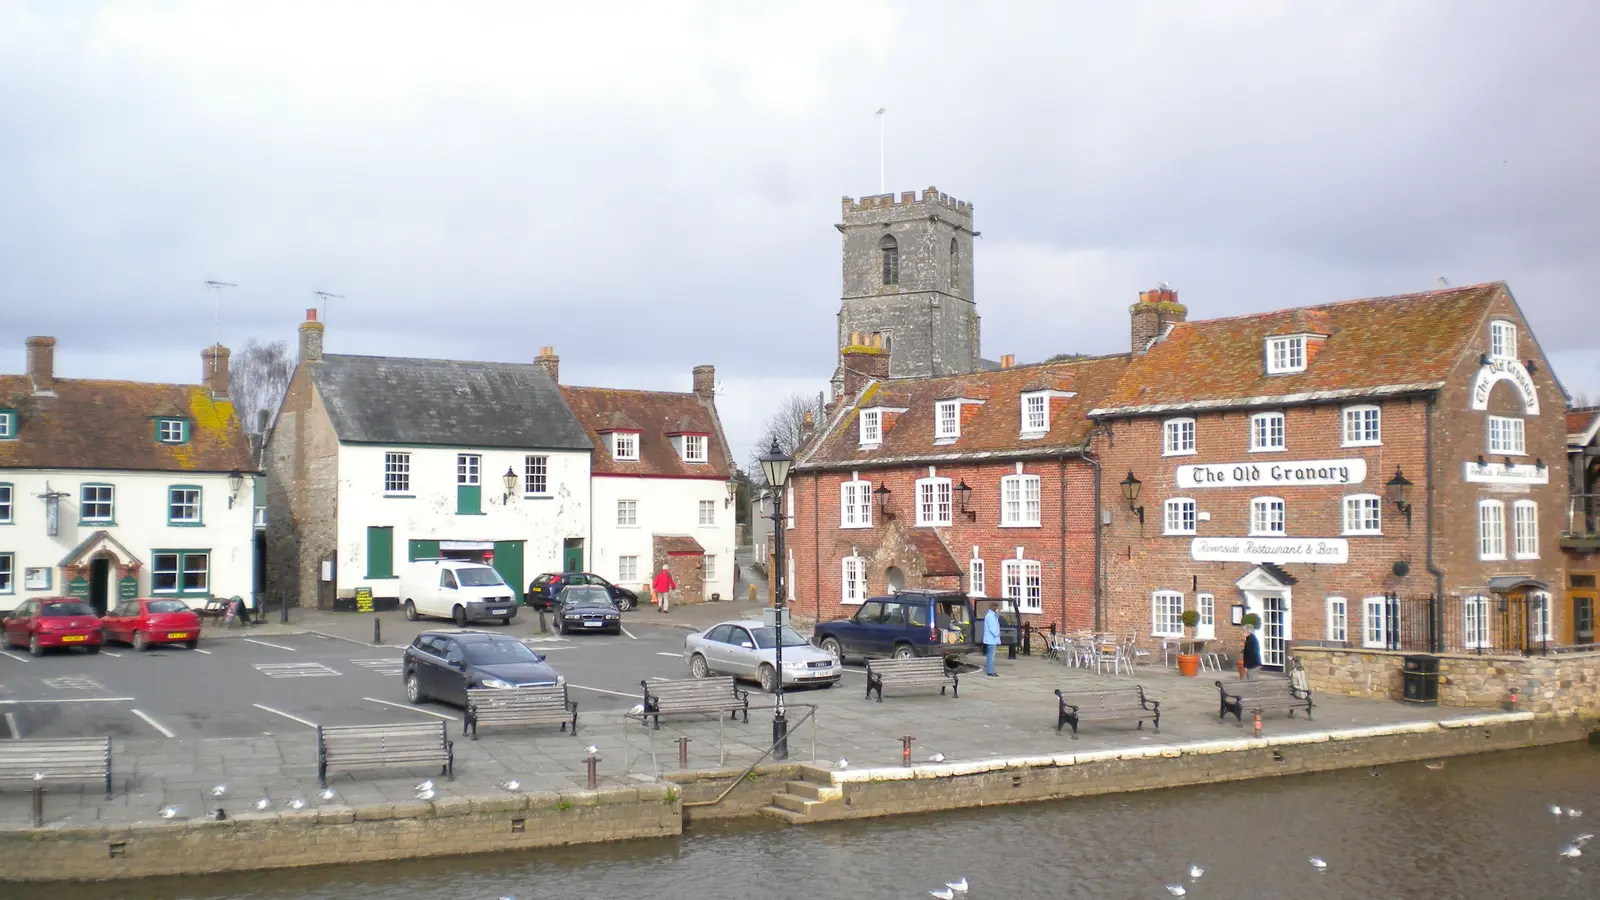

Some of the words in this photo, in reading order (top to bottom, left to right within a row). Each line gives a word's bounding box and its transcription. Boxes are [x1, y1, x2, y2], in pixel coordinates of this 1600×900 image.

[1476, 377, 1490, 403] The
[1489, 359, 1504, 375] Old
[1507, 360, 1535, 407] Granary
[1193, 466, 1225, 483] The
[1233, 465, 1260, 482] Old
[1271, 465, 1349, 483] Granary
[1198, 540, 1241, 555] Riverside
[1244, 540, 1304, 555] Restaurant
[1305, 543, 1313, 555] &
[1316, 541, 1340, 556] Bar
